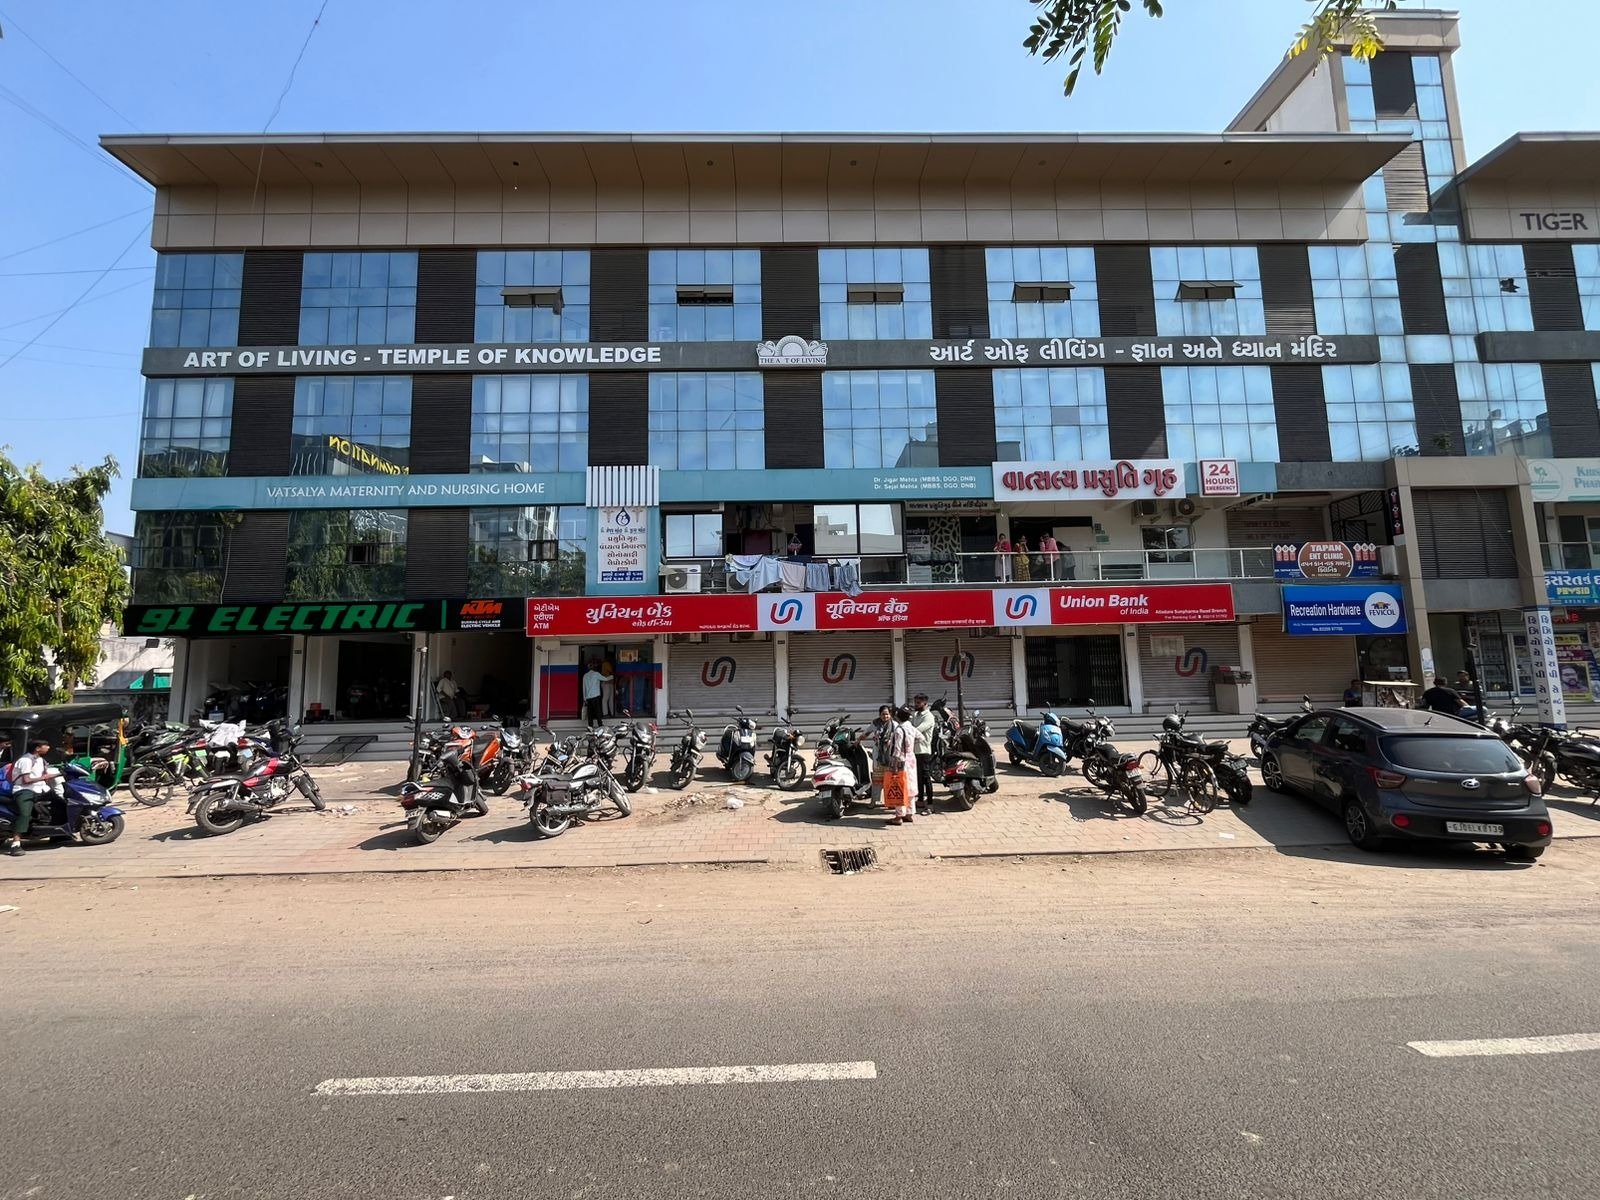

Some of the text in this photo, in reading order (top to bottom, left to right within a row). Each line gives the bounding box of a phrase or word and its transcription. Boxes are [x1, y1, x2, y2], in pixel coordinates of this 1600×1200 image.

[1520, 212, 1588, 230] TIGER
[930, 338, 975, 361] આર્ટ
[984, 338, 1029, 363] ઓફ
[1039, 338, 1105, 359] લીવિંગ
[1131, 343, 1174, 362] જ્ઞાન
[1182, 336, 1223, 359] અને
[1232, 340, 1281, 358] ધ્યાન
[1290, 335, 1337, 358] મંદિર
[183, 351, 232, 368] ART
[238, 351, 270, 368] OF
[277, 349, 357, 367] LIVING
[377, 348, 470, 365] TEMPLE
[477, 348, 508, 364] OF
[515, 347, 661, 364] KNOWLEDGE
[1208, 463, 1231, 476] 24
[1002, 460, 1177, 497] વાત્સલ્ય પ્રસુતિ ગૃહ
[1205, 477, 1236, 485] HOURS
[267, 482, 545, 498] VATSALYA MATERNITY AND NURSING HOME
[1310, 544, 1342, 552] TAPAN
[460, 600, 503, 615] KTM
[826, 598, 909, 619] यूनियन बैंक
[1060, 594, 1148, 608] Union Bank
[137, 603, 425, 632] 91 ELECTRIC
[585, 603, 643, 624] યુનિયન
[1120, 607, 1149, 615] of India
[1290, 603, 1361, 616] Recreation Hardware
